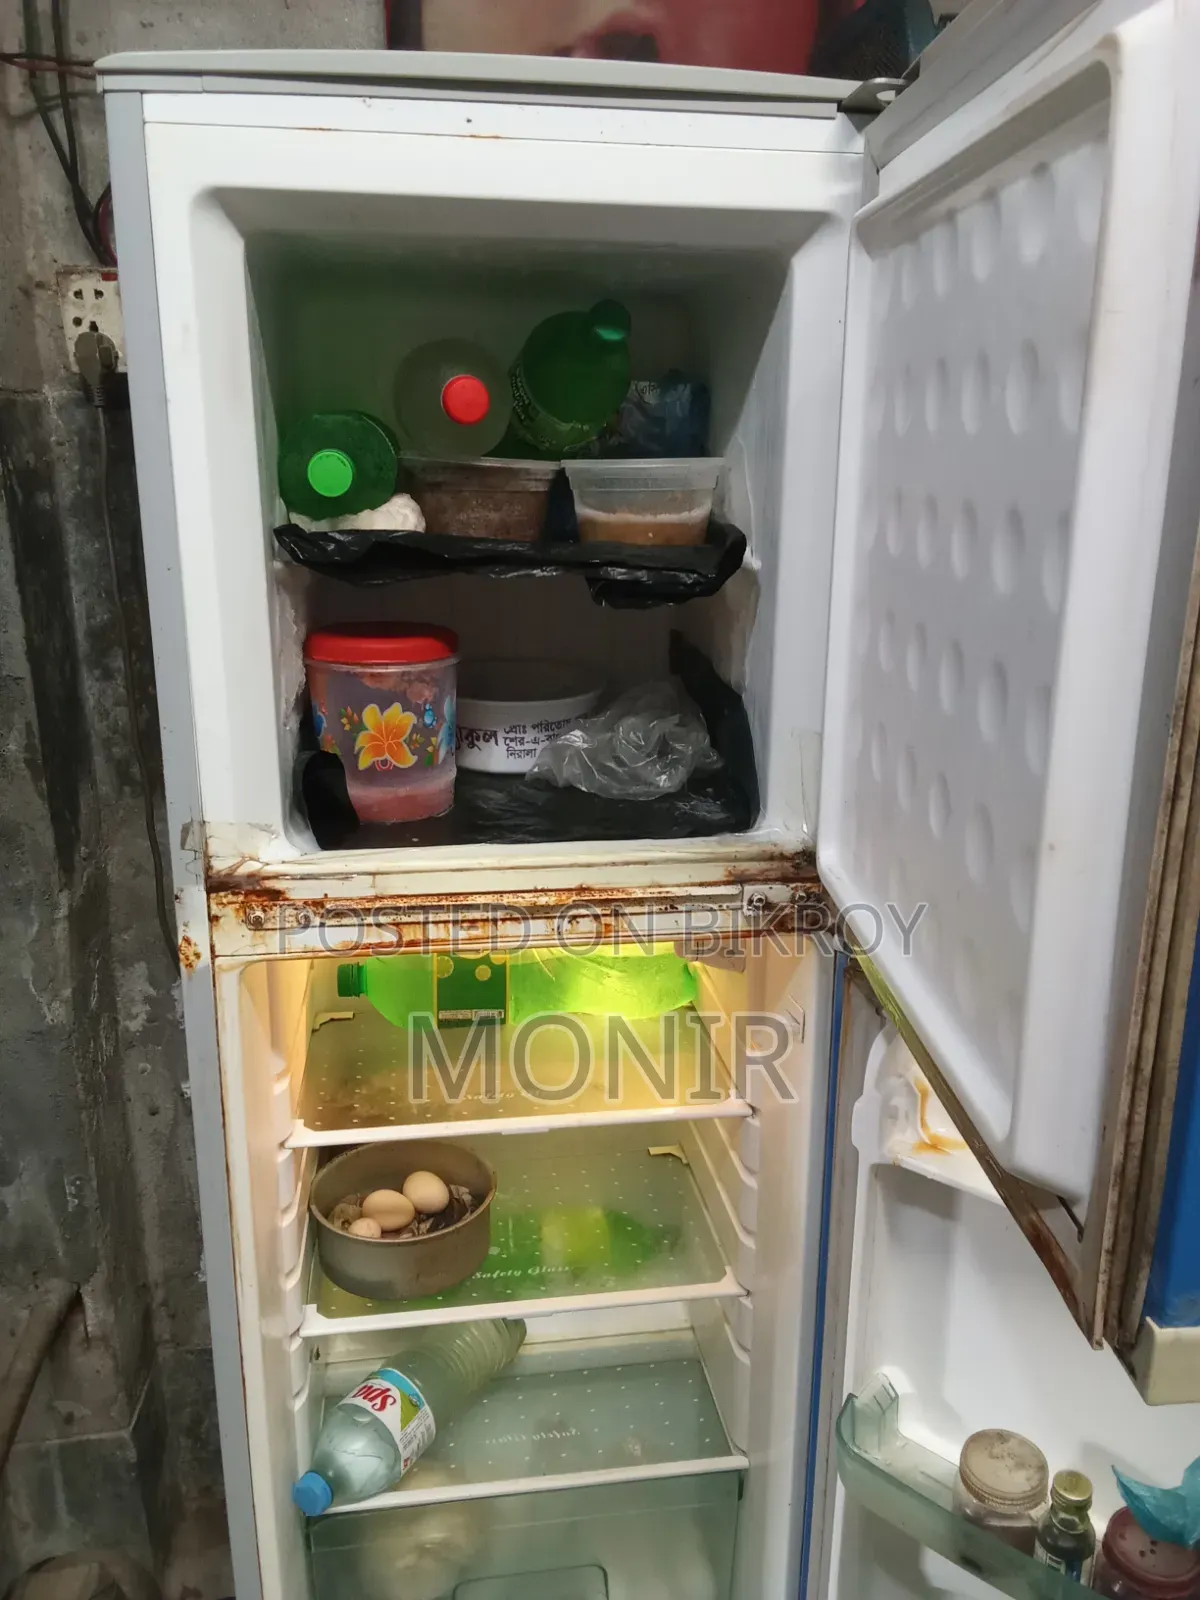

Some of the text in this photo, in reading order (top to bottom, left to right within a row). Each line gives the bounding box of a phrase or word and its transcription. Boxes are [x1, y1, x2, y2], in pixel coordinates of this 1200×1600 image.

[472, 1265, 573, 1280] Safety Glass
[350, 1384, 397, 1412] Spa
